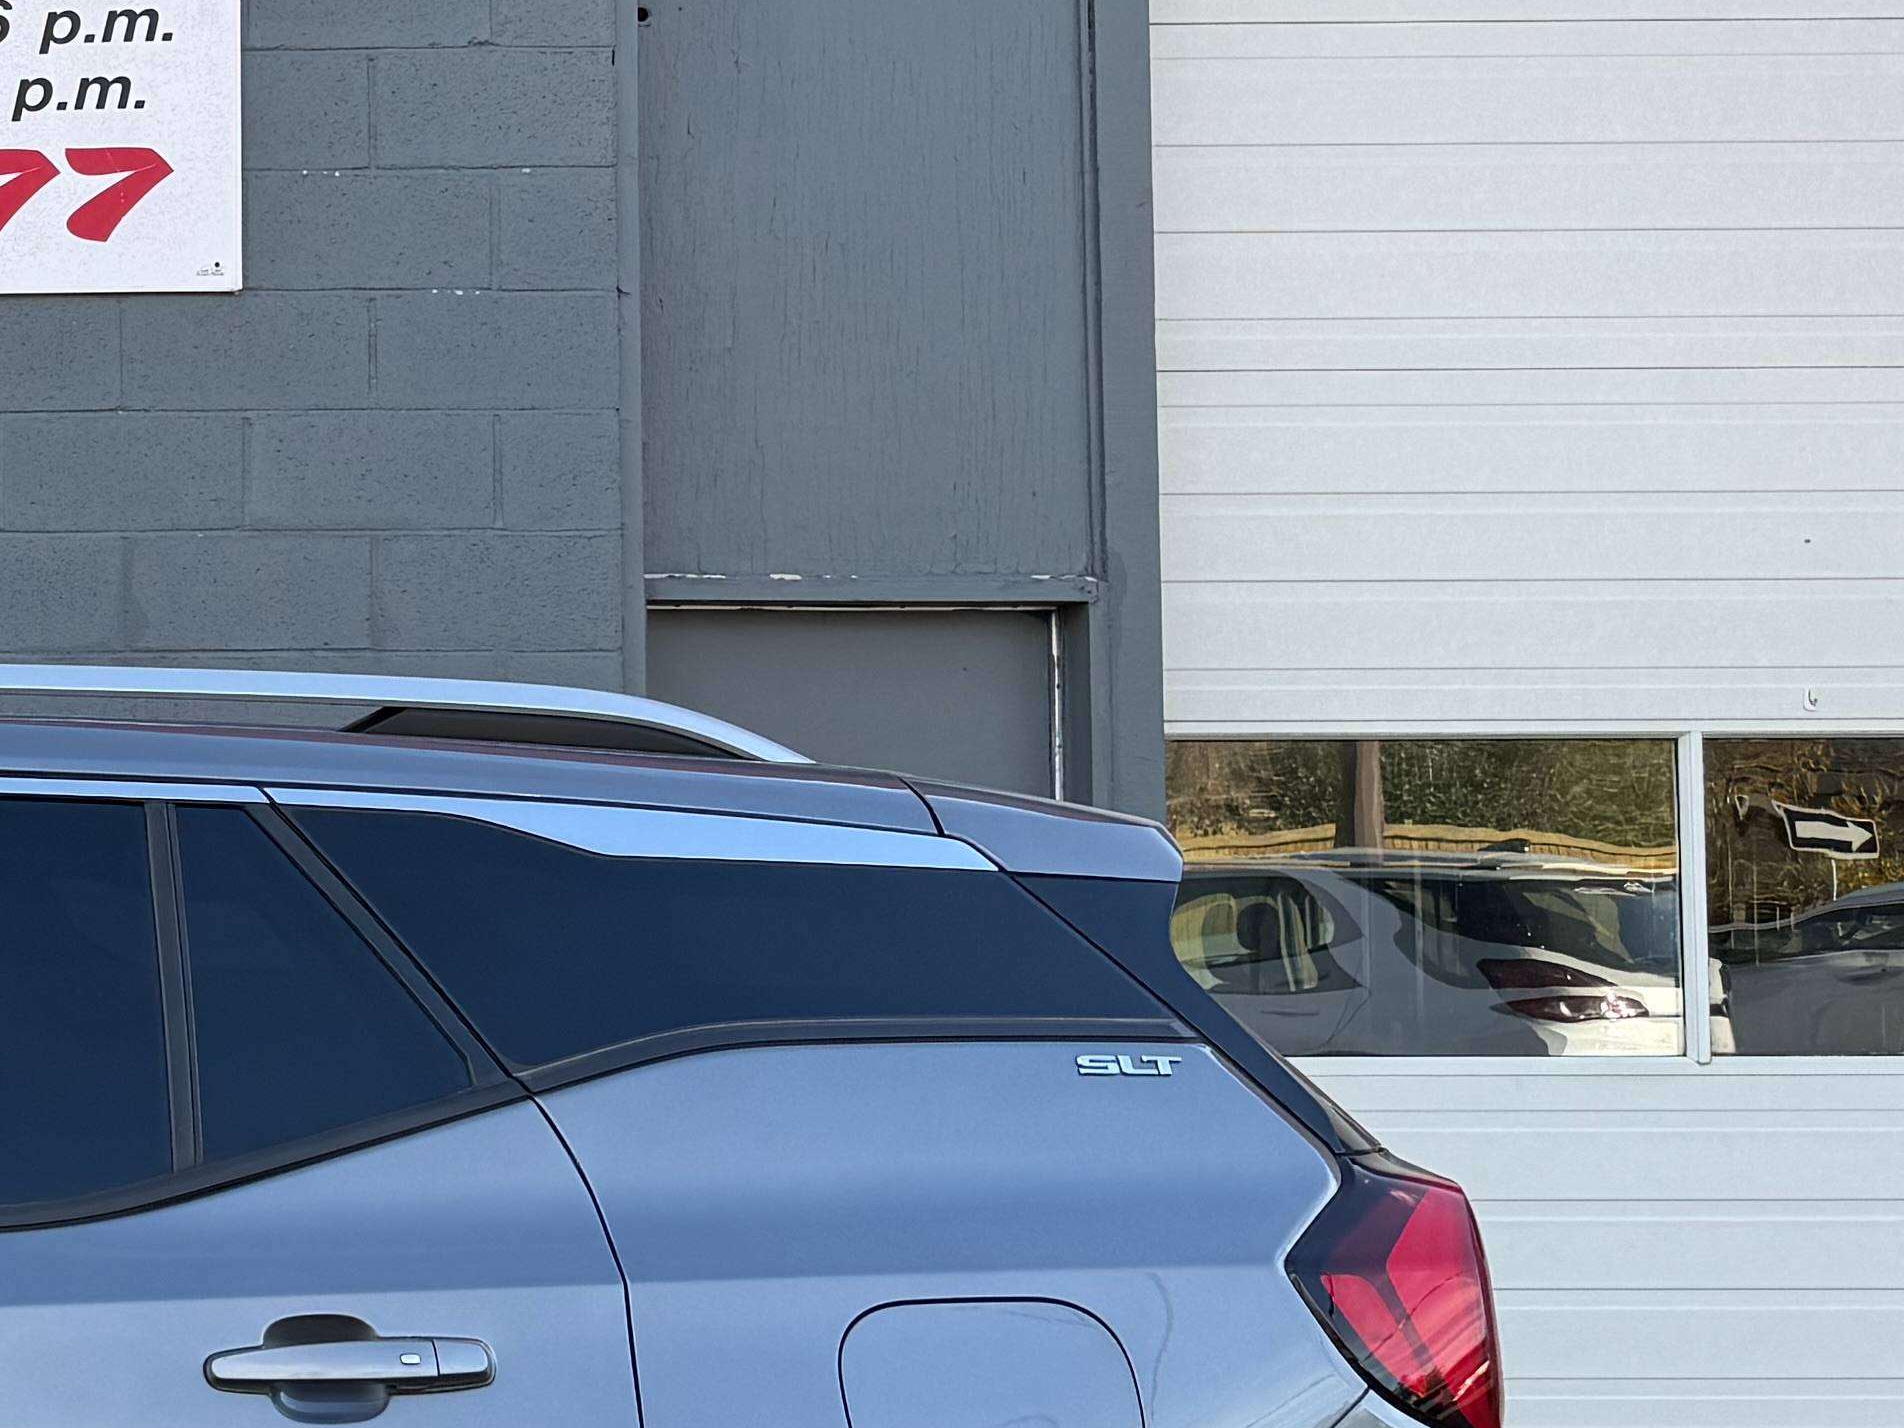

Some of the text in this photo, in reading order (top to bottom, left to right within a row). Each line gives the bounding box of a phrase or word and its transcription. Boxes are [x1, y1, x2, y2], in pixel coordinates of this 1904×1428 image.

[39, 9, 172, 54] p.m.
[12, 77, 145, 121] p.m.
[1076, 1055, 1182, 1076] SLT
